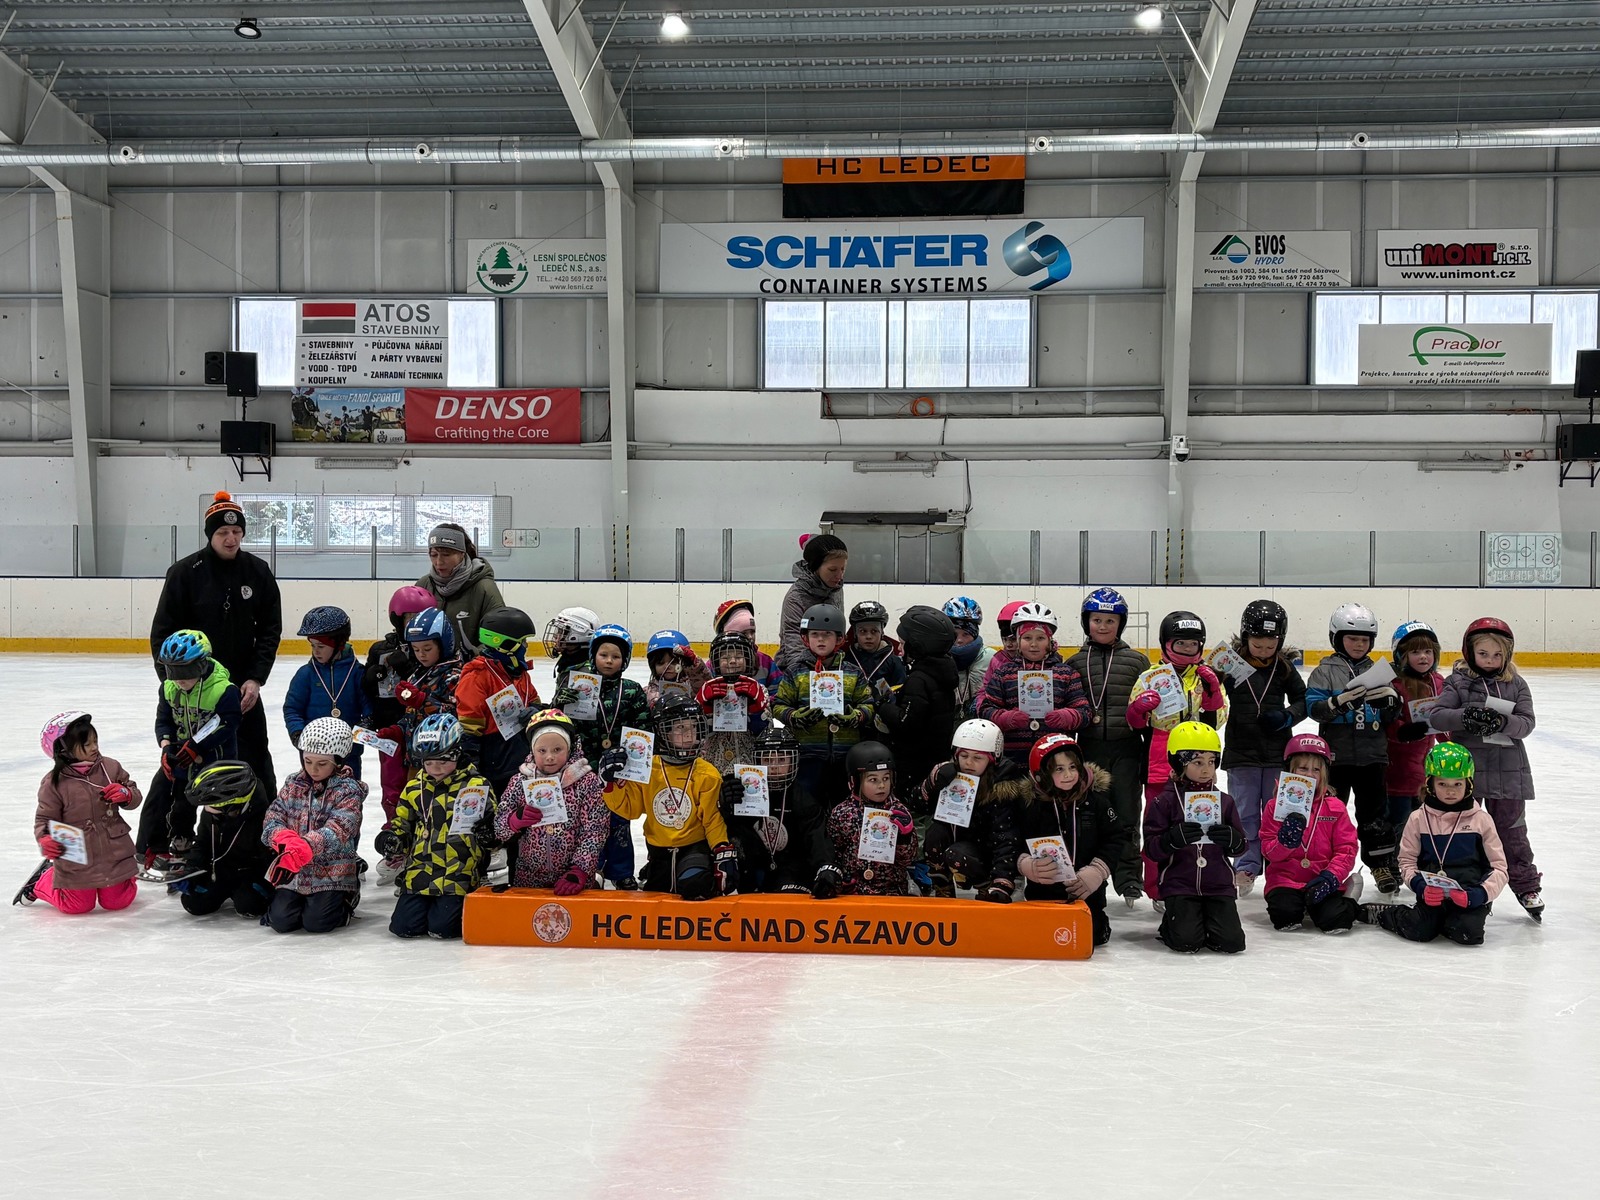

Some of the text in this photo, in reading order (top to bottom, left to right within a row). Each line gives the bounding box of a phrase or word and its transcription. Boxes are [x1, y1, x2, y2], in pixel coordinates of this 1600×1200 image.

[817, 158, 861, 175] HC
[1255, 234, 1286, 255] EVOS
[726, 234, 988, 269] SCHÄFER
[533, 252, 556, 262] LESNÍ
[1254, 256, 1285, 265] HYDRO
[542, 263, 568, 272] LEDEČ
[570, 264, 588, 273] N.S.,
[1401, 269, 1516, 279] www.unimont.cz
[759, 277, 988, 294] CONTAINER SYSTEMS
[363, 303, 430, 322] ATOS
[362, 325, 440, 335] STAVEBNINY
[308, 341, 354, 349] STAVEBNINY
[371, 339, 443, 350] PŮJČOVNA NÁŘADÍ
[1431, 338, 1503, 350] Pracolor
[308, 351, 357, 361] ŽELEZÁŘSTVÍ
[371, 353, 443, 363] A PÁRTY VYBAVENÍ
[308, 364, 329, 373] VODO
[337, 364, 358, 373] TOPO
[370, 370, 443, 380] ZAHRADNÍ TECHNIKA
[1436, 370, 1459, 378] výroba
[308, 376, 347, 385] KOUPELNY
[347, 391, 371, 403] FANDÍ
[371, 392, 401, 403] SPORTU
[435, 396, 552, 420] DENSO
[435, 426, 550, 442] Crafting the Core
[592, 914, 631, 938] HC
[640, 911, 733, 942] LEDEČ
[740, 917, 808, 944] NAD
[814, 913, 959, 947] SÁZAVOU
